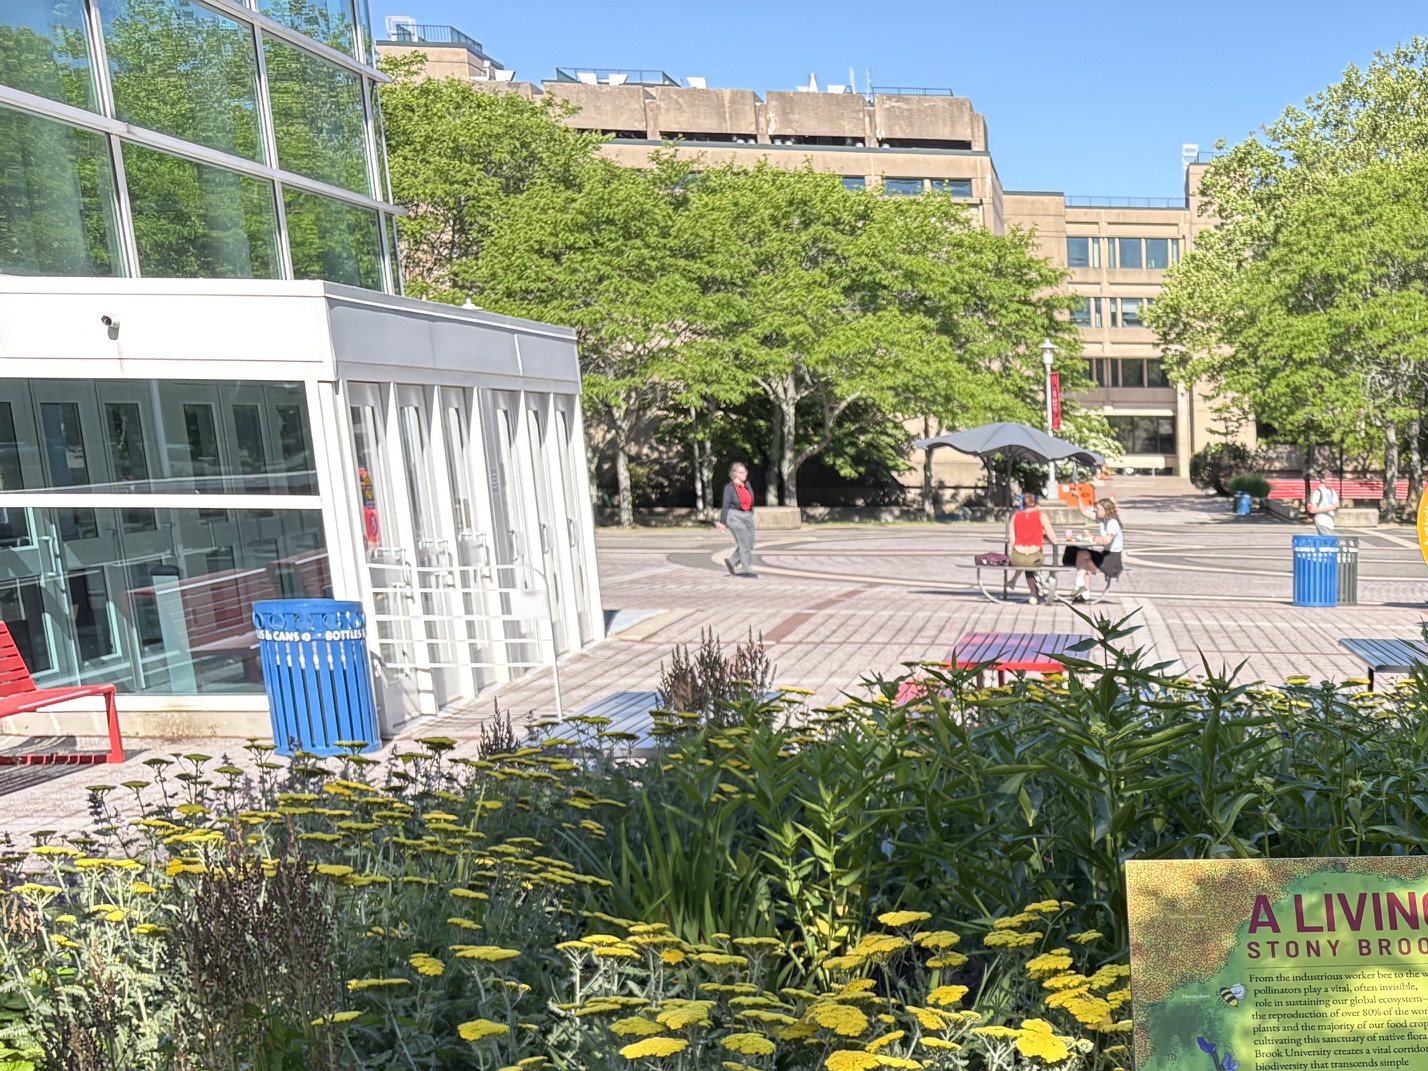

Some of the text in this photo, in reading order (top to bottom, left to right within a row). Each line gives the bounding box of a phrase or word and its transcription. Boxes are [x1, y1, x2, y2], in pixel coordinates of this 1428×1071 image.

[273, 631, 300, 641] CANS
[325, 629, 361, 640] BOTTLES
[1247, 894, 1281, 934] A
[1246, 939, 1341, 958] STONY
[1252, 1023, 1280, 1035] plants
[1281, 1023, 1299, 1032] and
[1300, 1022, 1315, 1031] the
[1317, 1022, 1355, 1033] majority
[1356, 1020, 1367, 1029] of
[1386, 1019, 1407, 1028] food
[1253, 1035, 1302, 1047] cultivating
[1303, 1034, 1320, 1043] this
[1321, 1034, 1365, 1045] sanctuary
[1366, 1033, 1377, 1041] of
[1378, 1033, 1405, 1041] native
[1254, 1048, 1282, 1058] Brook
[1284, 1047, 1332, 1059] University
[1333, 1047, 1363, 1055] creates
[1372, 1045, 1391, 1054] vital
[1392, 1044, 1428, 1053] corridor
[1310, 1060, 1328, 1069] that
[1330, 1058, 1378, 1068] transcends
[1379, 1057, 1409, 1069] simple
